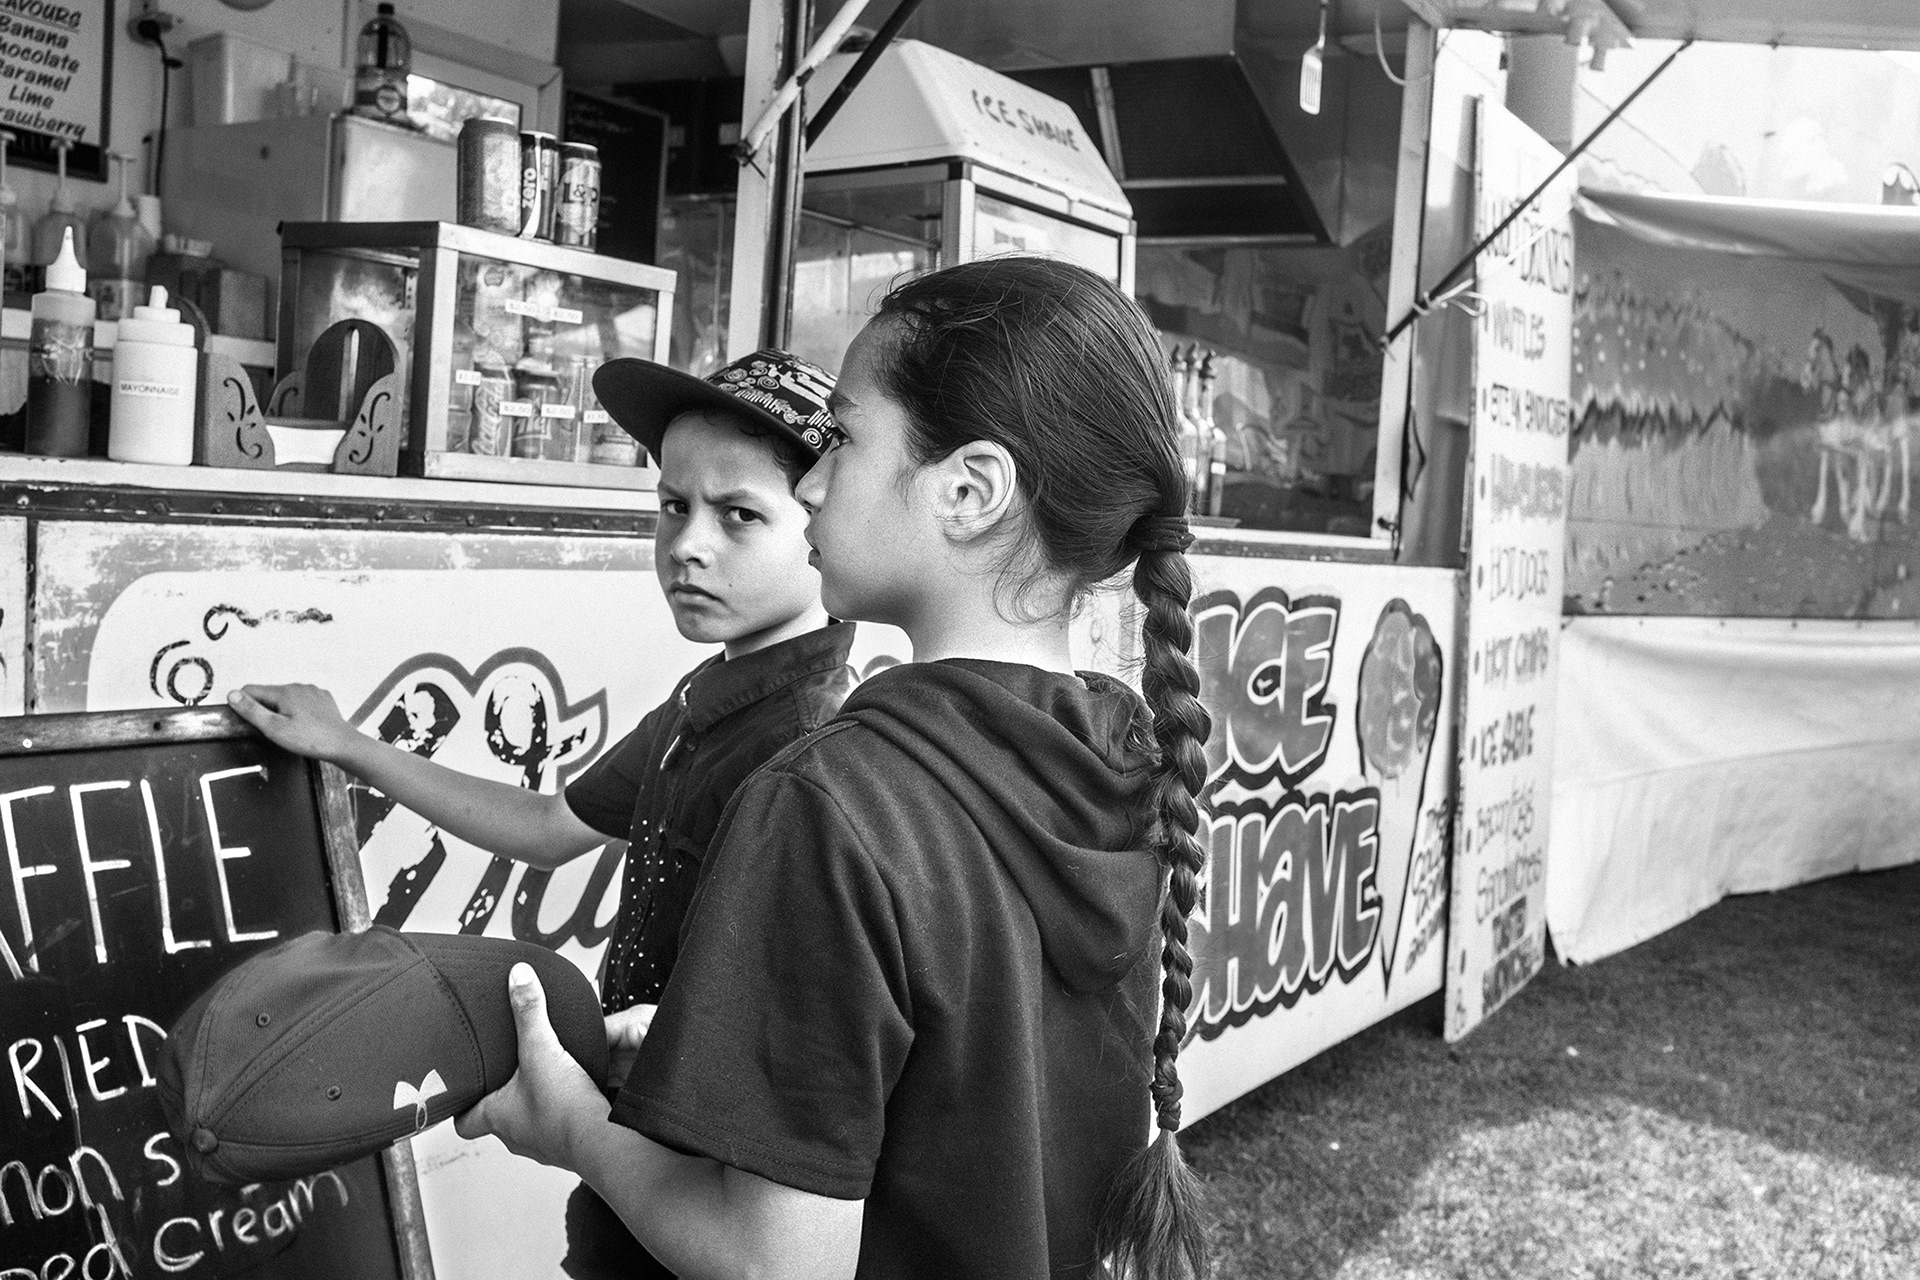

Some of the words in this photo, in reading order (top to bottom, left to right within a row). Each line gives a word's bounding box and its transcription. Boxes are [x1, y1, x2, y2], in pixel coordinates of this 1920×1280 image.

[0, 0, 81, 29] AVOURS
[0, 15, 69, 49] Banana
[9, 84, 54, 109] Lime
[972, 89, 1017, 128] ICE
[1017, 108, 1080, 152] SHAVE
[1484, 636, 1513, 686] HOT
[1193, 592, 1341, 790] ICE
[0, 765, 279, 980] FFLE
[153, 1170, 349, 1272] Cream
